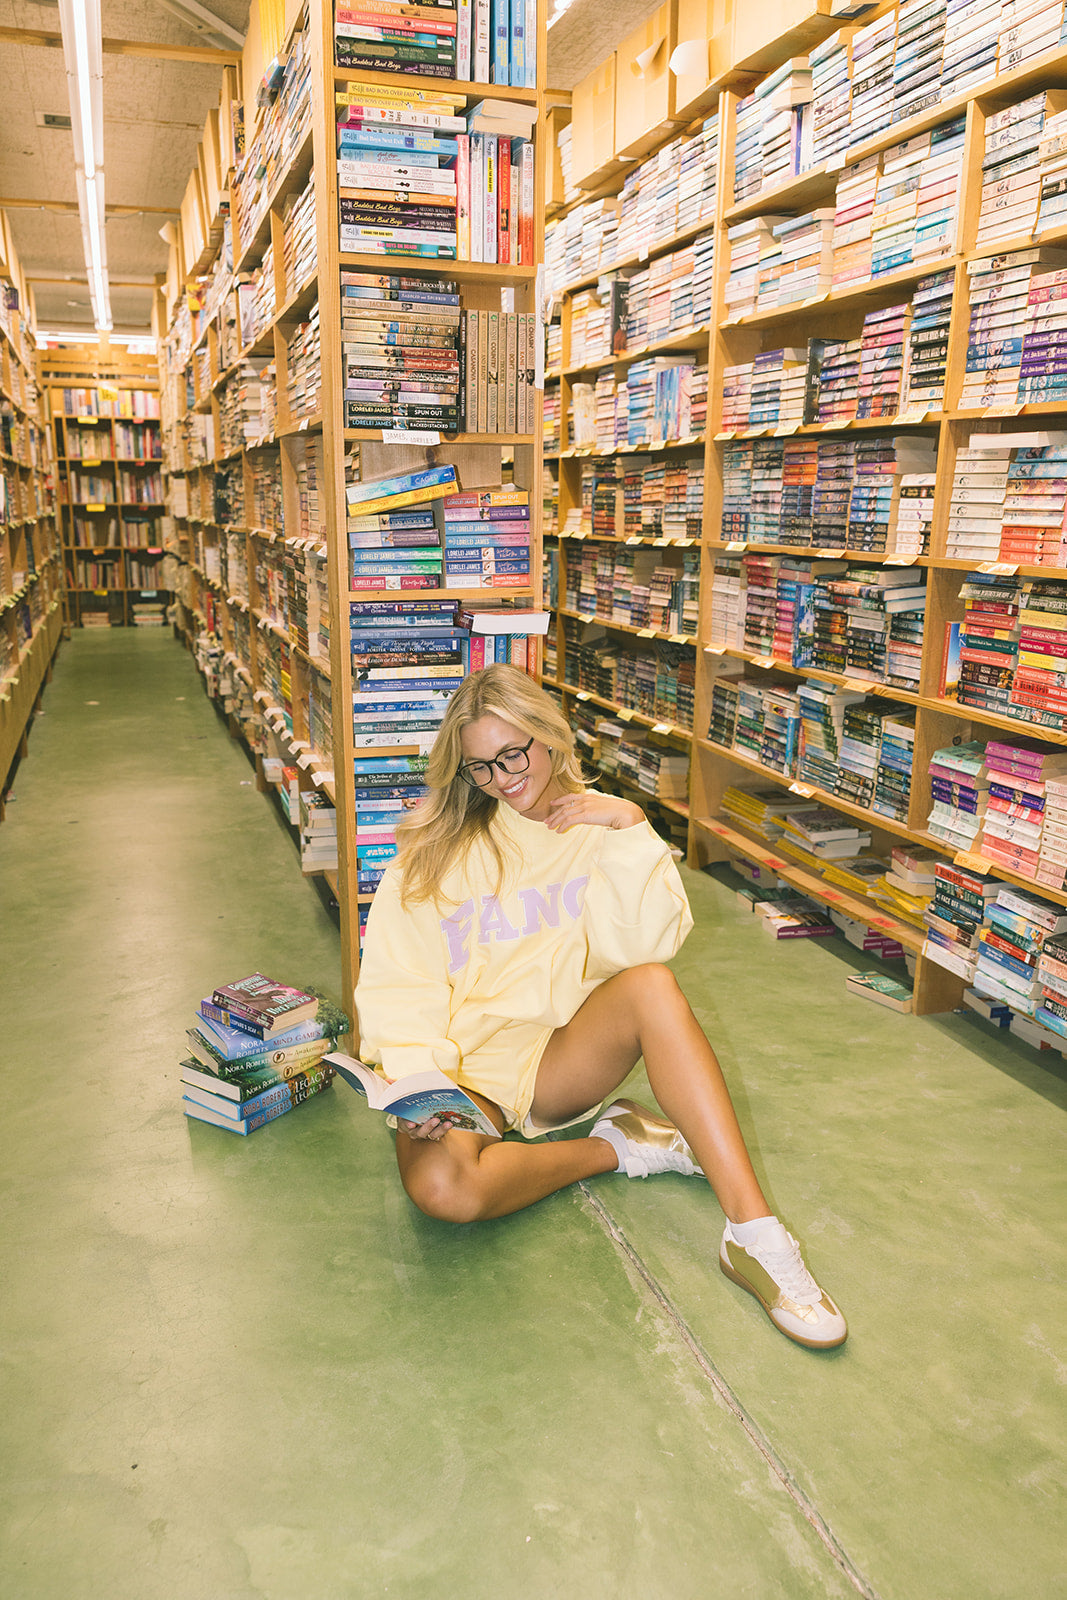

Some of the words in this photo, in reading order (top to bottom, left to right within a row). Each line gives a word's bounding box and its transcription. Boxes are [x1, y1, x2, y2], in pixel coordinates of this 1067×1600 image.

[352, 57, 373, 66] Baddest
[374, 60, 386, 68] Bad
[387, 60, 401, 70] Boys
[388, 204, 401, 212] Boys
[354, 214, 376, 222] Baddest
[390, 217, 402, 226] Boys
[416, 474, 439, 485] CAGED
[1020, 681, 1034, 692] BLIND
[1036, 684, 1048, 694] SPOT
[940, 894, 952, 906] FACE
[951, 899, 960, 910] OFF
[247, 1024, 257, 1034] SCAR
[272, 1036, 293, 1046] MIND
[294, 1030, 321, 1042] GAMES
[240, 1040, 264, 1050] NORA
[236, 1046, 270, 1059] ROBERTS
[224, 1064, 244, 1074] NORA
[245, 1058, 270, 1070] ROBERTS
[294, 1070, 326, 1094] LEGACY
[246, 1085, 262, 1096] NORA
[294, 1083, 322, 1104] LEGACY
[243, 1100, 260, 1118] NORA
[261, 1087, 289, 1108] ROBERTS
[249, 1114, 266, 1130] NORA
[266, 1100, 290, 1121] ROBERTS
